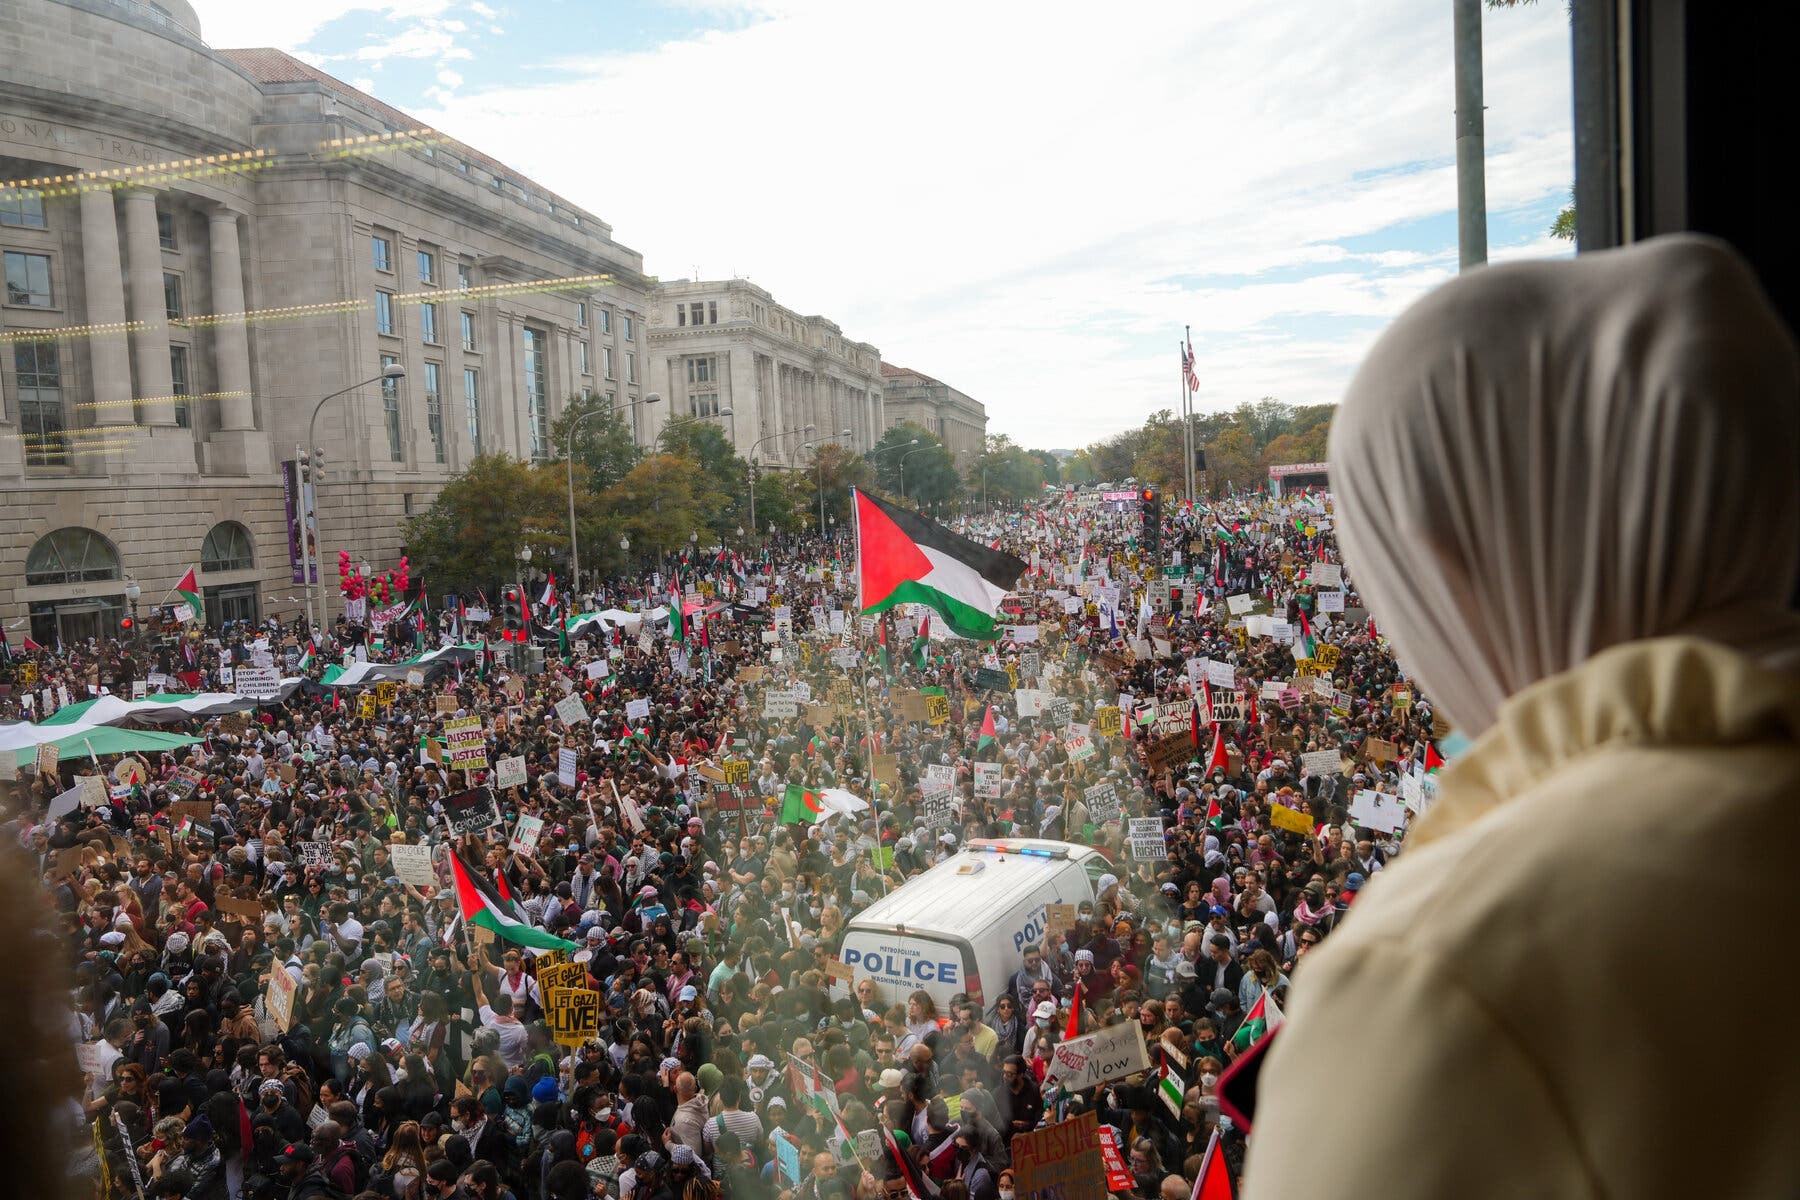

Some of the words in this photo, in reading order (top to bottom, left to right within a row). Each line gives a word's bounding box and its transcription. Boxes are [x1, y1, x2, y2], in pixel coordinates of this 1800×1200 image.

[1065, 736, 1086, 752] STOP
[451, 748, 486, 762] JUSTICE
[734, 764, 748, 772] GAZA
[714, 784, 730, 792] THIS
[925, 796, 951, 815] FREE
[1087, 787, 1117, 811] FREE
[460, 806, 478, 818] THE
[454, 812, 493, 832] GENOCIDE
[1135, 845, 1165, 857] RIGHT!
[537, 955, 551, 970] END
[553, 948, 565, 964] THE
[880, 946, 920, 957] METROPOLITAN
[845, 948, 957, 984] POLICE
[543, 974, 560, 990] LET
[561, 964, 585, 982] GAZA
[555, 995, 571, 1008] LET
[573, 994, 597, 1007] GAZA
[555, 1006, 597, 1031] LIVE!
[1011, 1113, 1101, 1170] PALESTINE
